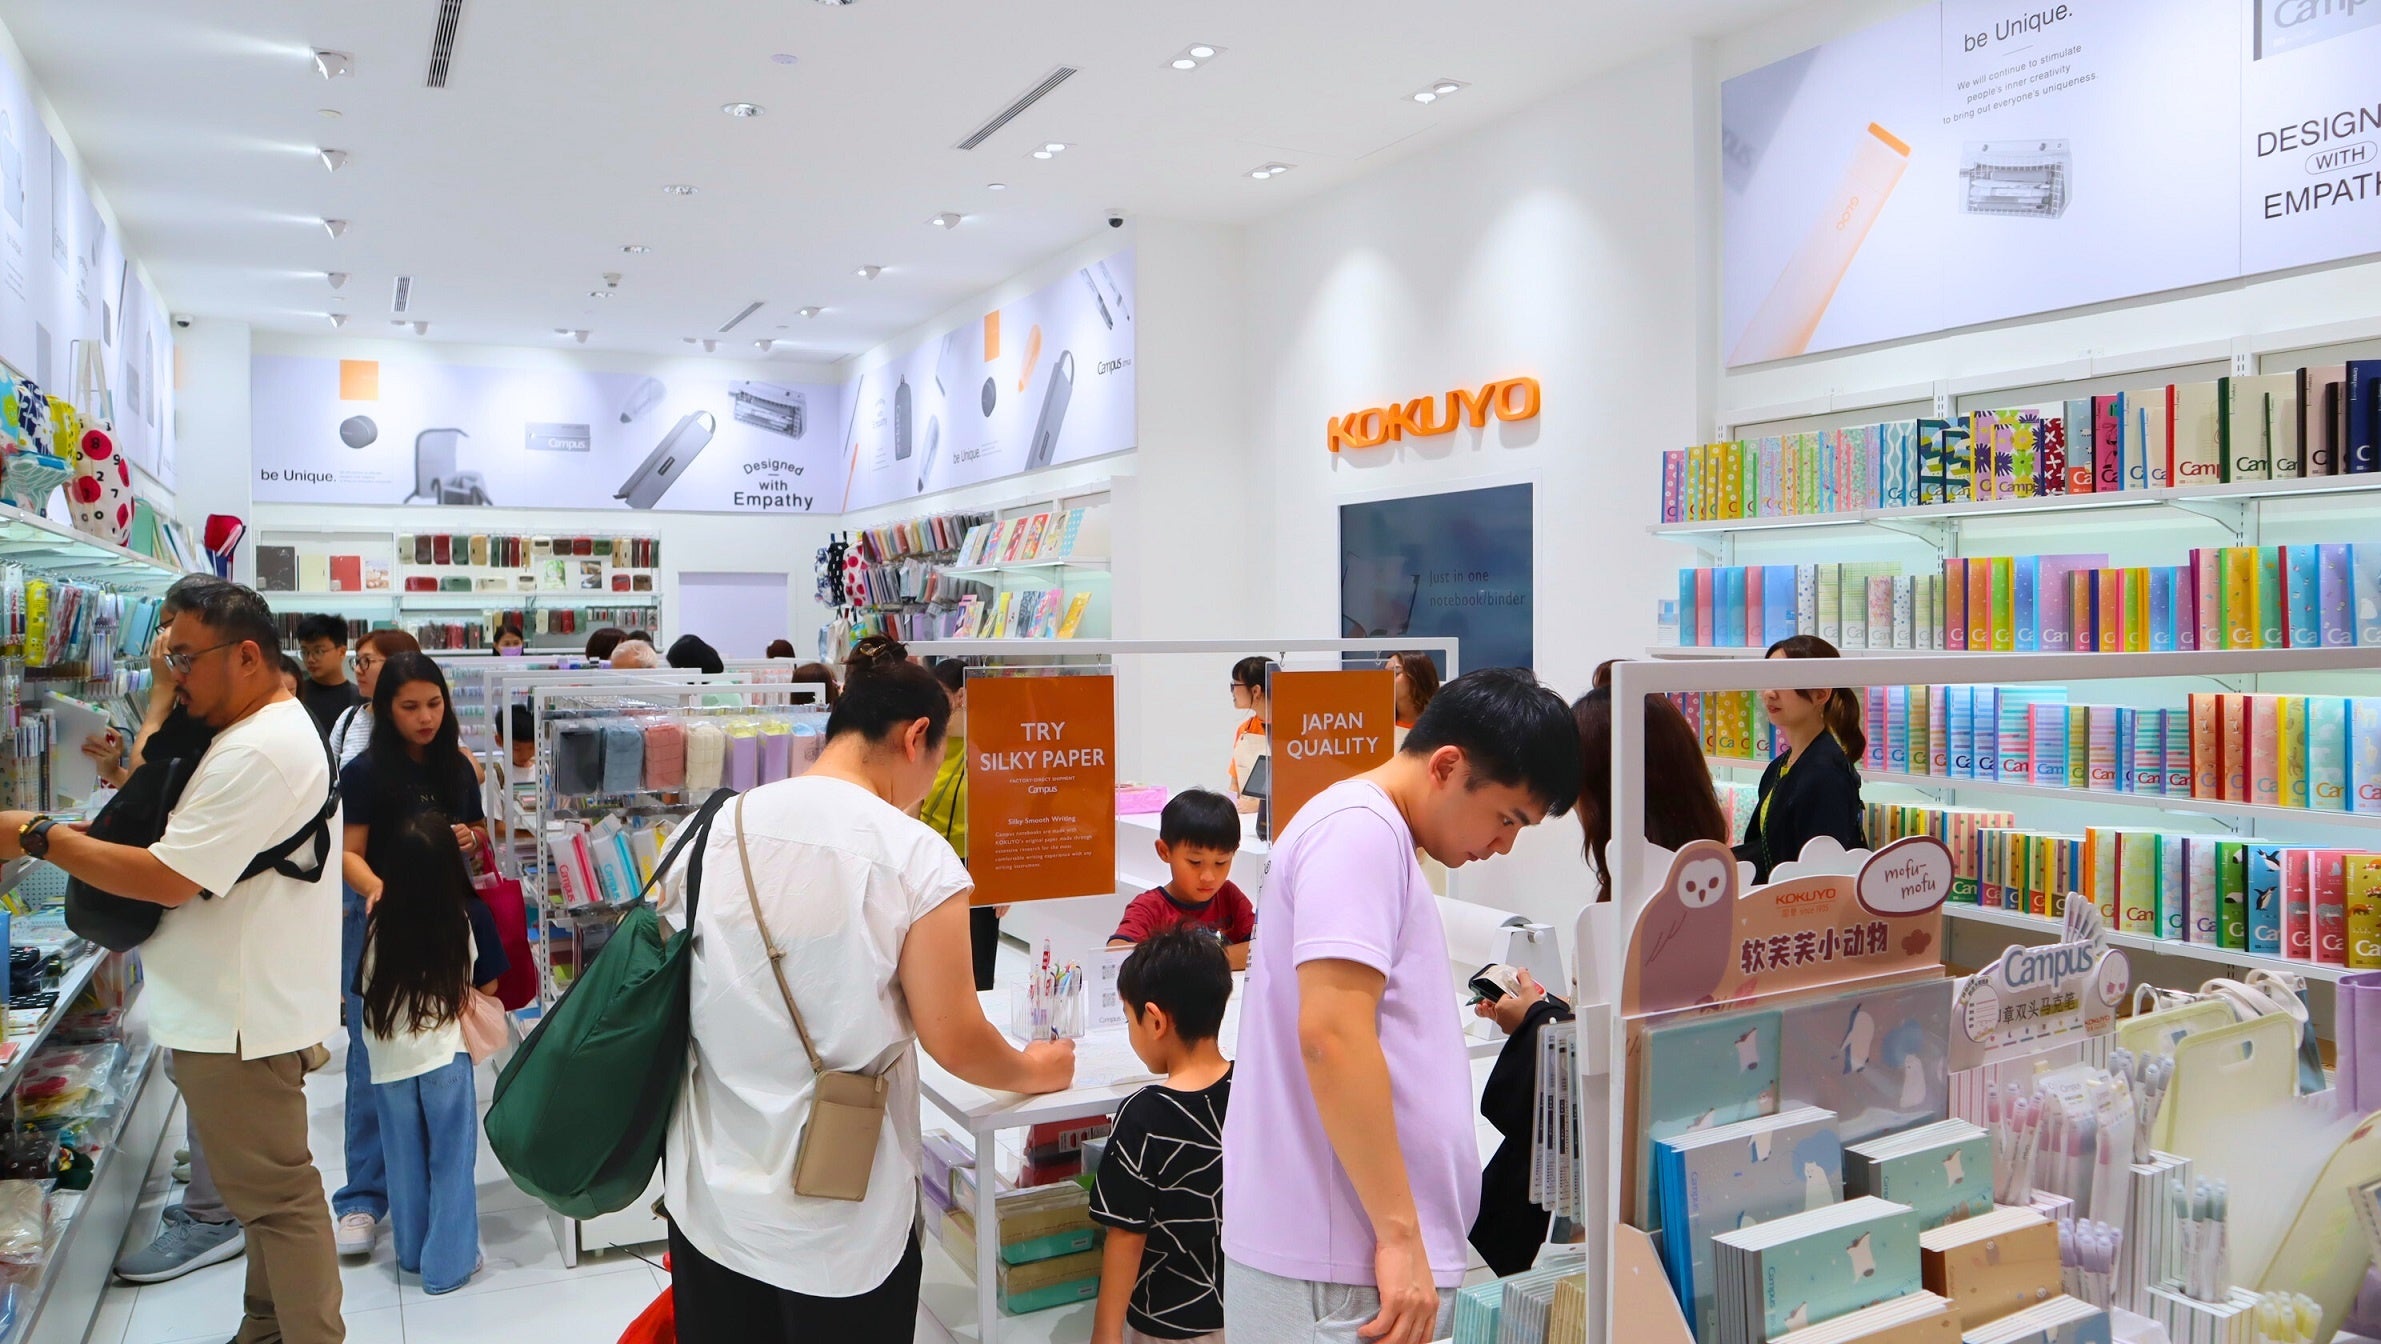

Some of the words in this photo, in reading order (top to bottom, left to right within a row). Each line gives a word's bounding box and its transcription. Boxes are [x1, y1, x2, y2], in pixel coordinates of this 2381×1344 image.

[1964, 34, 1988, 53] be
[1995, 4, 2073, 41] Unique.
[1957, 80, 1971, 91] We
[1973, 74, 1987, 87] will
[1988, 62, 2026, 81] continue
[2028, 58, 2038, 68] to
[2040, 44, 2082, 65] stimulate
[1967, 86, 2003, 104] people's
[2005, 78, 2027, 92] inner
[2029, 64, 2071, 84] creativity
[1943, 116, 1951, 125] to
[1953, 109, 1975, 122] bring
[1977, 103, 1991, 116] out
[1993, 88, 2040, 110] everyone's
[2315, 146, 2365, 170] WITH
[1327, 377, 1541, 453] KOKUYO
[548, 438, 586, 452] Campus
[261, 469, 279, 481] be
[284, 469, 337, 484] Unique.
[743, 458, 804, 476] Designed
[759, 480, 788, 491] with
[734, 491, 813, 511] Empathy
[1429, 570, 1449, 587] Just
[1454, 571, 1463, 582] in
[1468, 570, 1489, 582] one
[1430, 592, 1527, 607] notebook/binder
[1021, 722, 1065, 741] TRY
[1301, 712, 1363, 735] JAPAN
[1287, 737, 1379, 759] QUALITY
[980, 751, 1035, 771] SILKY
[1042, 749, 1105, 768] PAPER
[1028, 785, 1057, 794] Campus
[1008, 818, 1023, 826] Silky
[1051, 815, 1076, 823] Writing
[560, 864, 575, 902] Campus
[1900, 874, 1935, 899] mofu
[1775, 888, 1836, 905] KOKUYO
[1741, 921, 1888, 974] 软芙芙小动物
[2004, 944, 2094, 987] Campus
[1998, 991, 2075, 1024] 章双头马克笔
